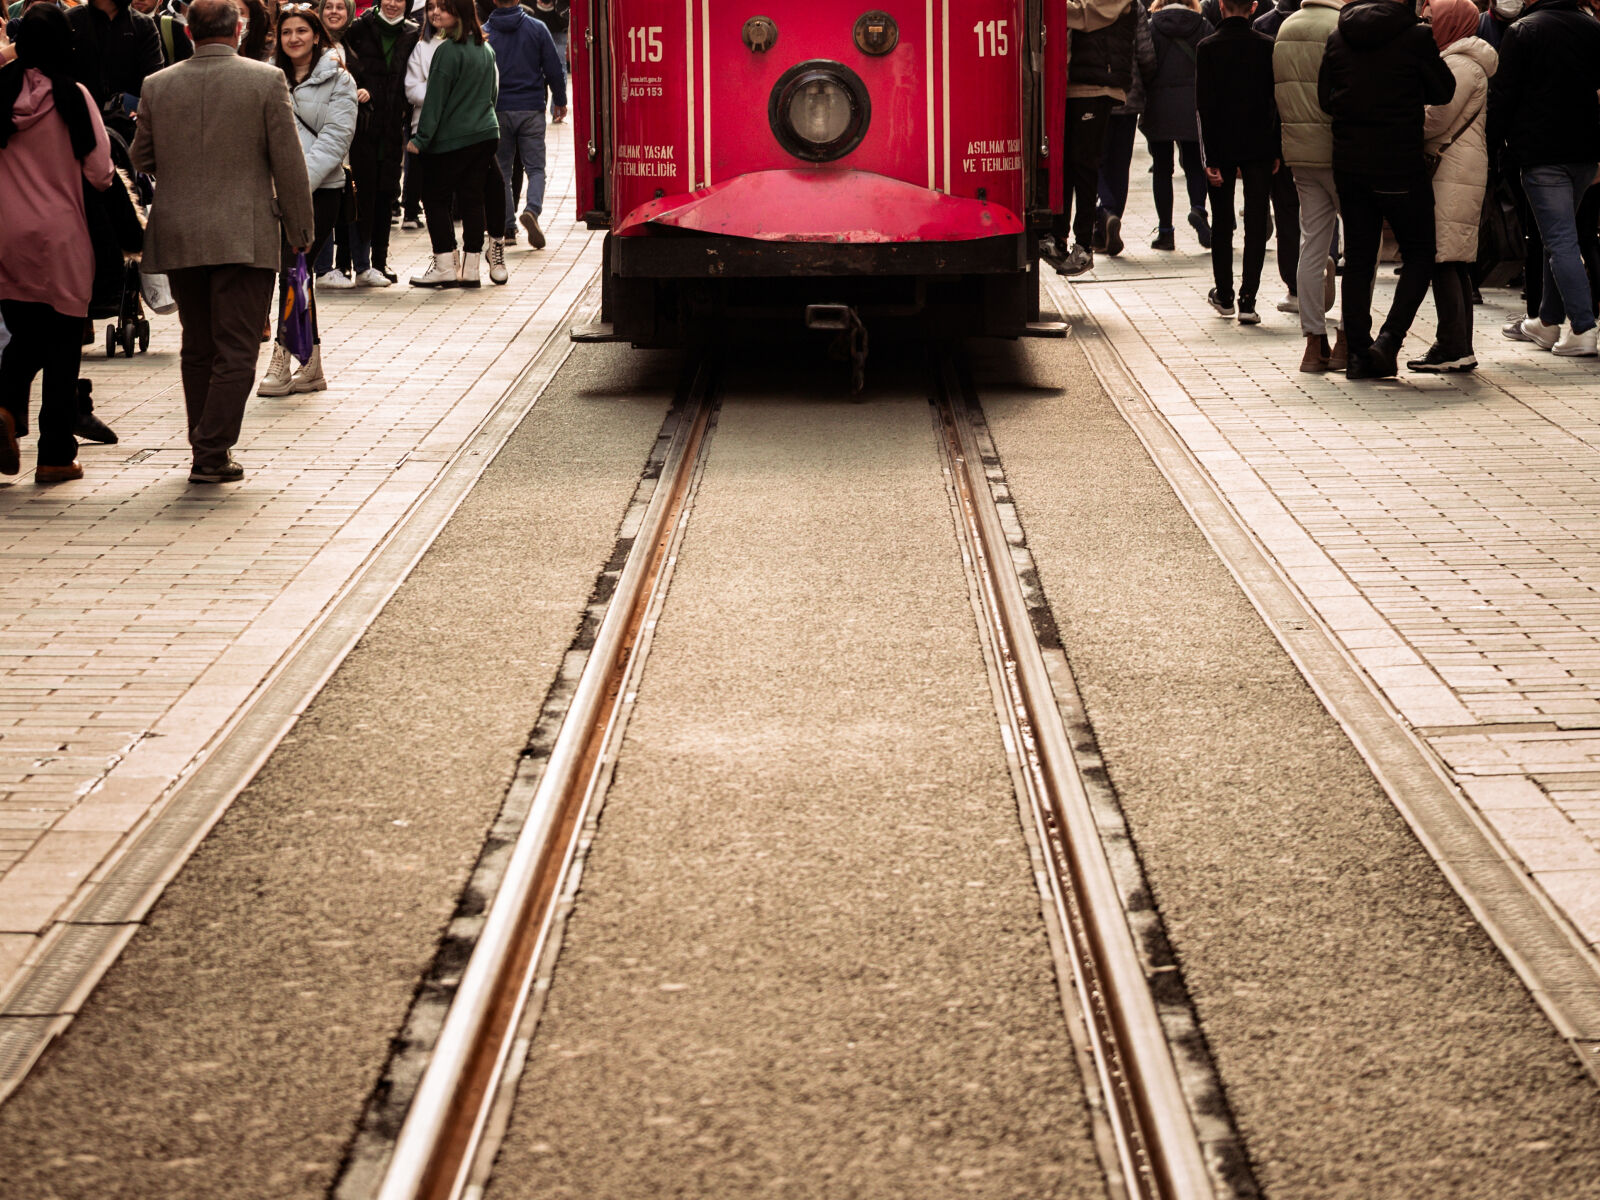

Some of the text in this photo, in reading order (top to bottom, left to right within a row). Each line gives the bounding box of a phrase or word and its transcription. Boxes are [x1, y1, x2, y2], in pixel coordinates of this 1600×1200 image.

[627, 26, 663, 63] 115
[973, 19, 1008, 57] 115
[629, 87, 663, 97] ALO 153
[643, 145, 674, 160] YASAK
[967, 139, 1005, 155] ASILMAK
[623, 161, 677, 177] TEHLİKELİDİR
[962, 155, 1021, 173] VE TEHLİKEL
